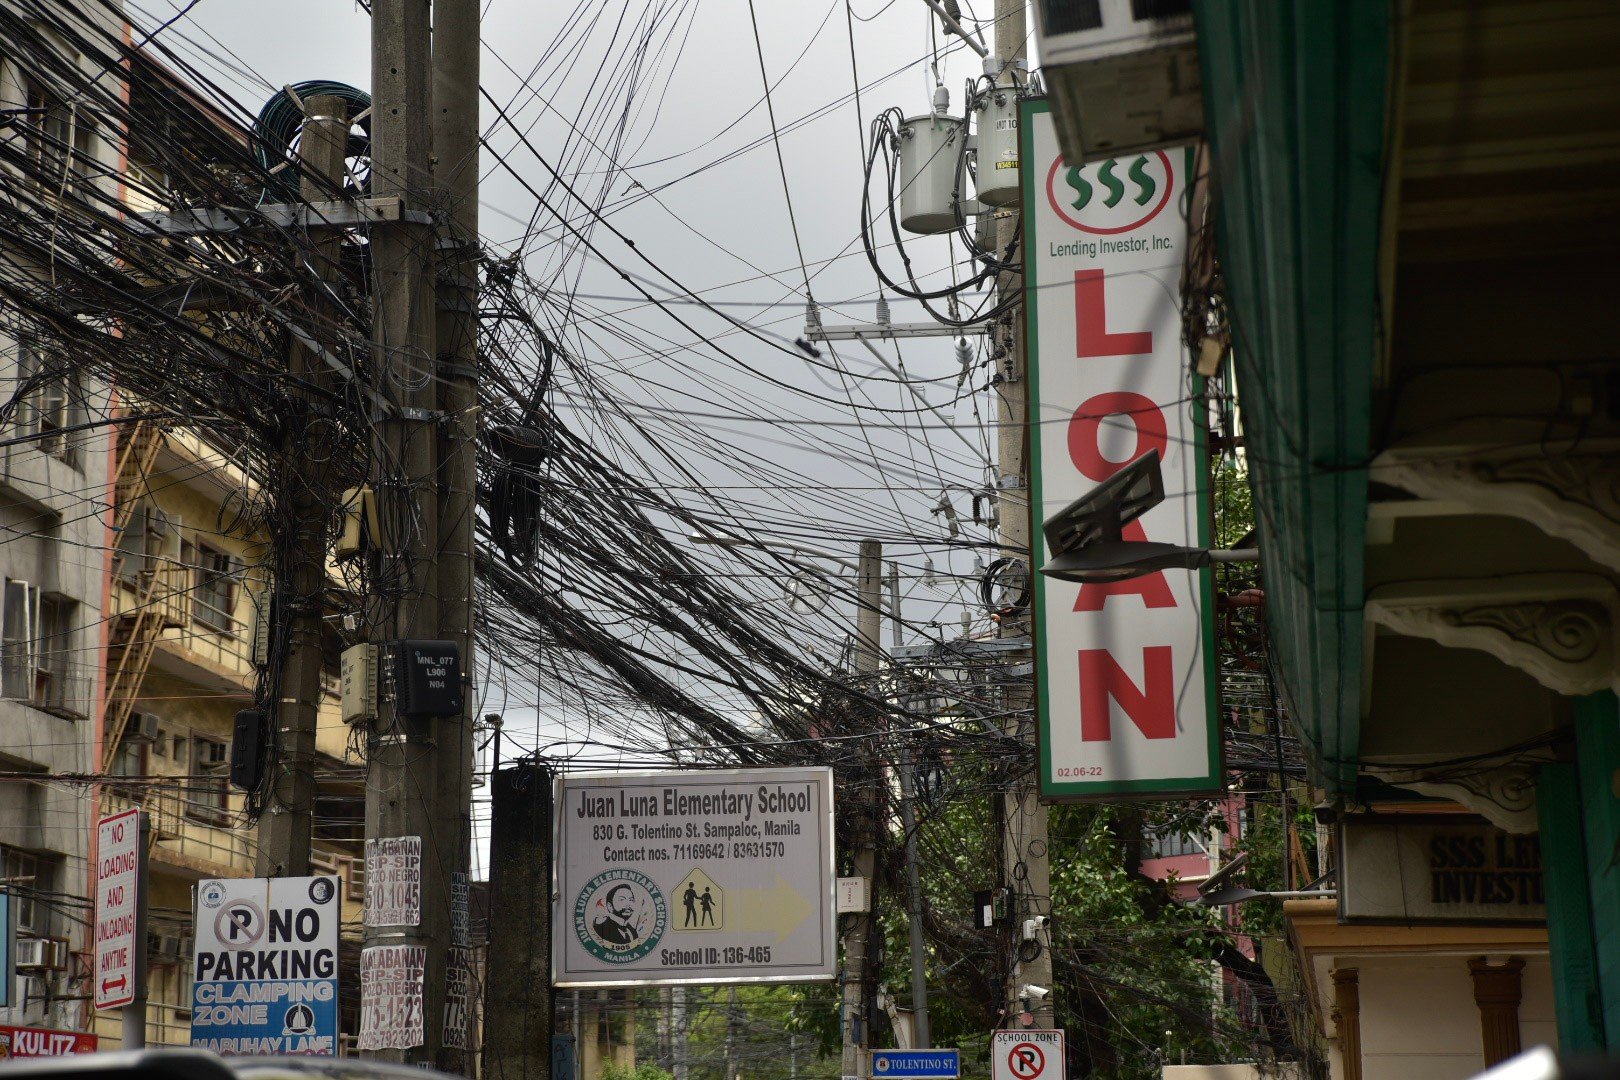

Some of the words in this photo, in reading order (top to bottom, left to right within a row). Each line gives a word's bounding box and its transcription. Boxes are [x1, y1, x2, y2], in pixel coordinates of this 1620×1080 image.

[1065, 155, 1156, 211] SSS
[1050, 240, 1096, 258] Lending
[1100, 237, 1149, 254] Investor,
[1152, 235, 1173, 250] Inc.
[418, 656, 454, 666] MNL_077
[1058, 767, 1102, 777] 02.06-22
[577, 791, 614, 818] Juan
[620, 790, 658, 817] Luna
[663, 788, 753, 821] Elementary
[758, 785, 810, 813] School
[112, 823, 124, 844] NO
[593, 824, 612, 840] 830
[616, 824, 628, 840] G.
[631, 823, 682, 839] Tolentino
[686, 822, 700, 838] St.
[704, 822, 760, 840] Sampaloc,
[764, 820, 800, 836] Manila
[368, 856, 420, 870] SIP-SIP
[604, 846, 646, 862] Contact
[648, 848, 670, 860] nos.
[673, 843, 724, 860] 71169642
[727, 843, 731, 858] /
[734, 842, 784, 858] 83631570
[1430, 835, 1484, 868] SSS
[100, 851, 134, 880] LOADING
[592, 870, 658, 896] ELEMENTARY
[106, 886, 124, 908] AND
[576, 886, 594, 913] LUNA
[98, 914, 132, 942] UNLOADING
[268, 908, 320, 942] NO
[576, 916, 591, 943] JUAN
[650, 896, 666, 940] SCHOOL
[102, 948, 127, 972] ANYTIME
[196, 949, 334, 981] PARKING
[361, 948, 425, 970] MALABANAN
[604, 952, 640, 962] MANILA
[661, 948, 702, 966] School
[705, 948, 720, 964] ID:
[722, 946, 771, 964] 136-465
[362, 969, 424, 983] SIP-SIP
[196, 981, 334, 1004] CLAMPING
[193, 1005, 268, 1026] ZONE
[362, 996, 422, 1030] 775-1523
[13, 1030, 76, 1056] KULITZ
[286, 1036, 332, 1054] LANE
[998, 1034, 1032, 1042] SCHOOL
[1036, 1034, 1058, 1042] ZONE
[891, 1059, 941, 1070] TOLENTINO
[943, 1059, 956, 1069] ST.
